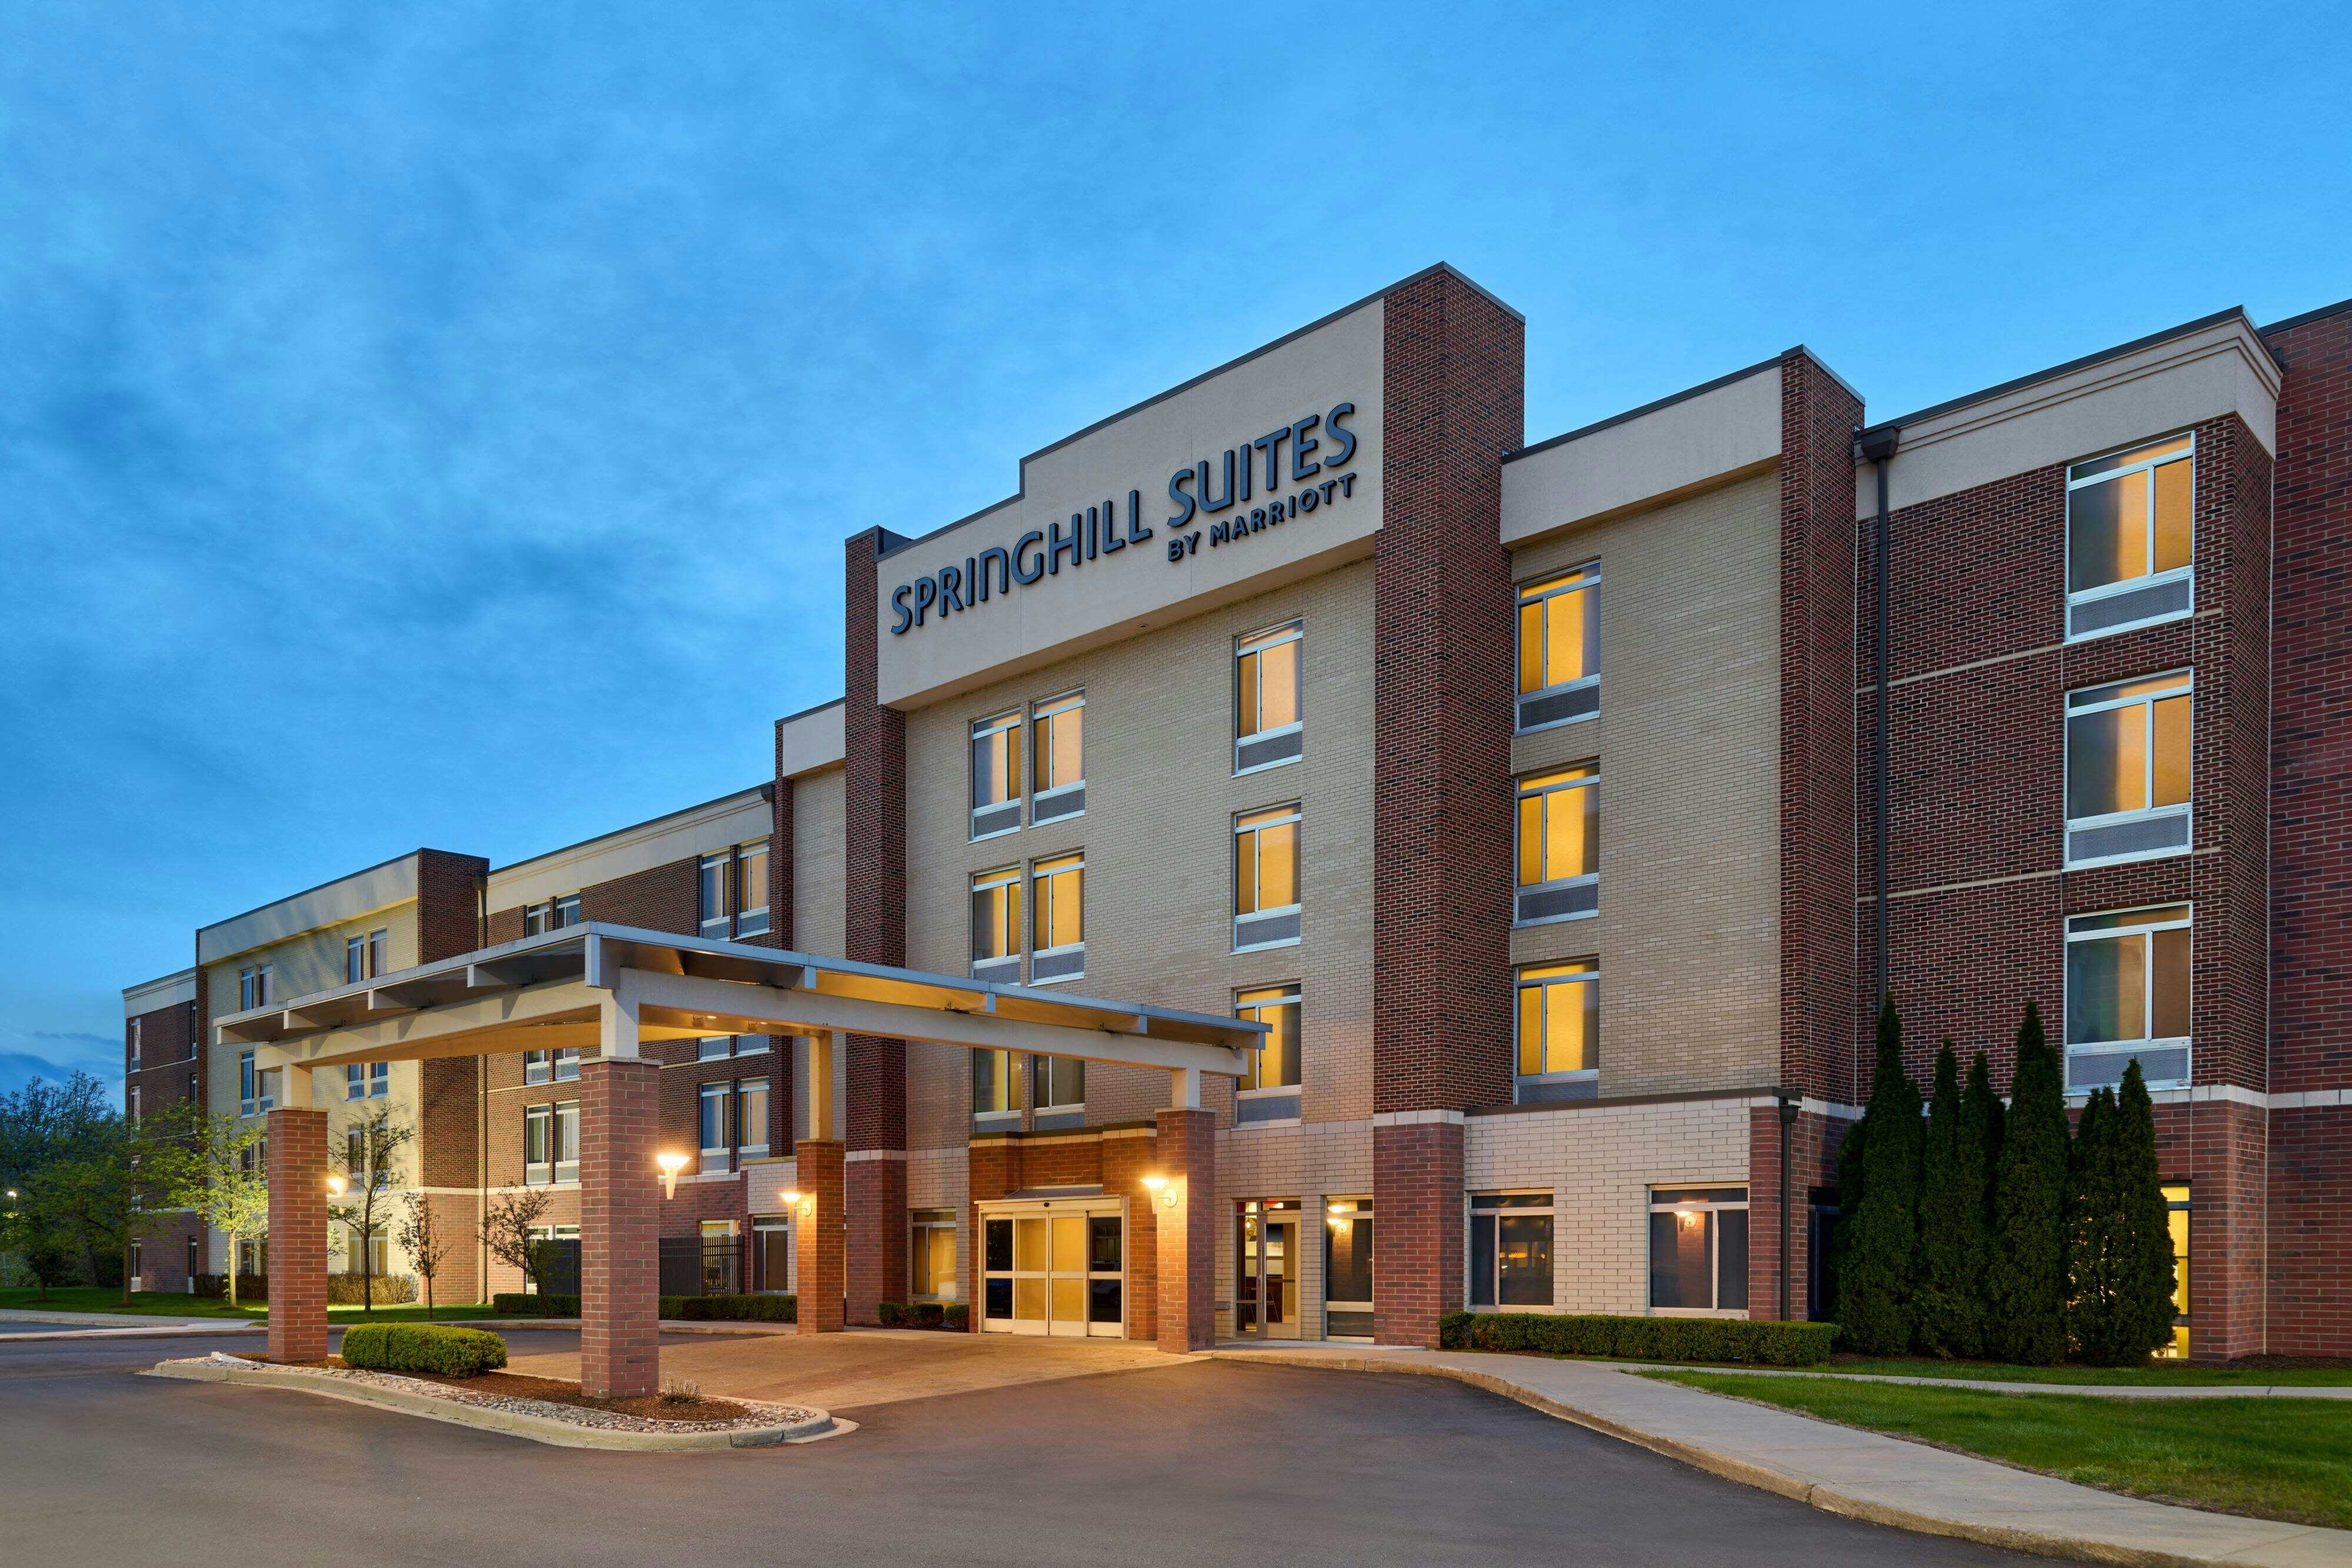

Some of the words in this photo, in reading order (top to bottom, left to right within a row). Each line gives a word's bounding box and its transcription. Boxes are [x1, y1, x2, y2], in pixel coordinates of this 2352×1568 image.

[891, 489, 1152, 635] SPRINGHILL
[1167, 403, 1357, 527] SUITES
[1168, 531, 1201, 562] BY
[1210, 472, 1357, 547] MARRIOTT
